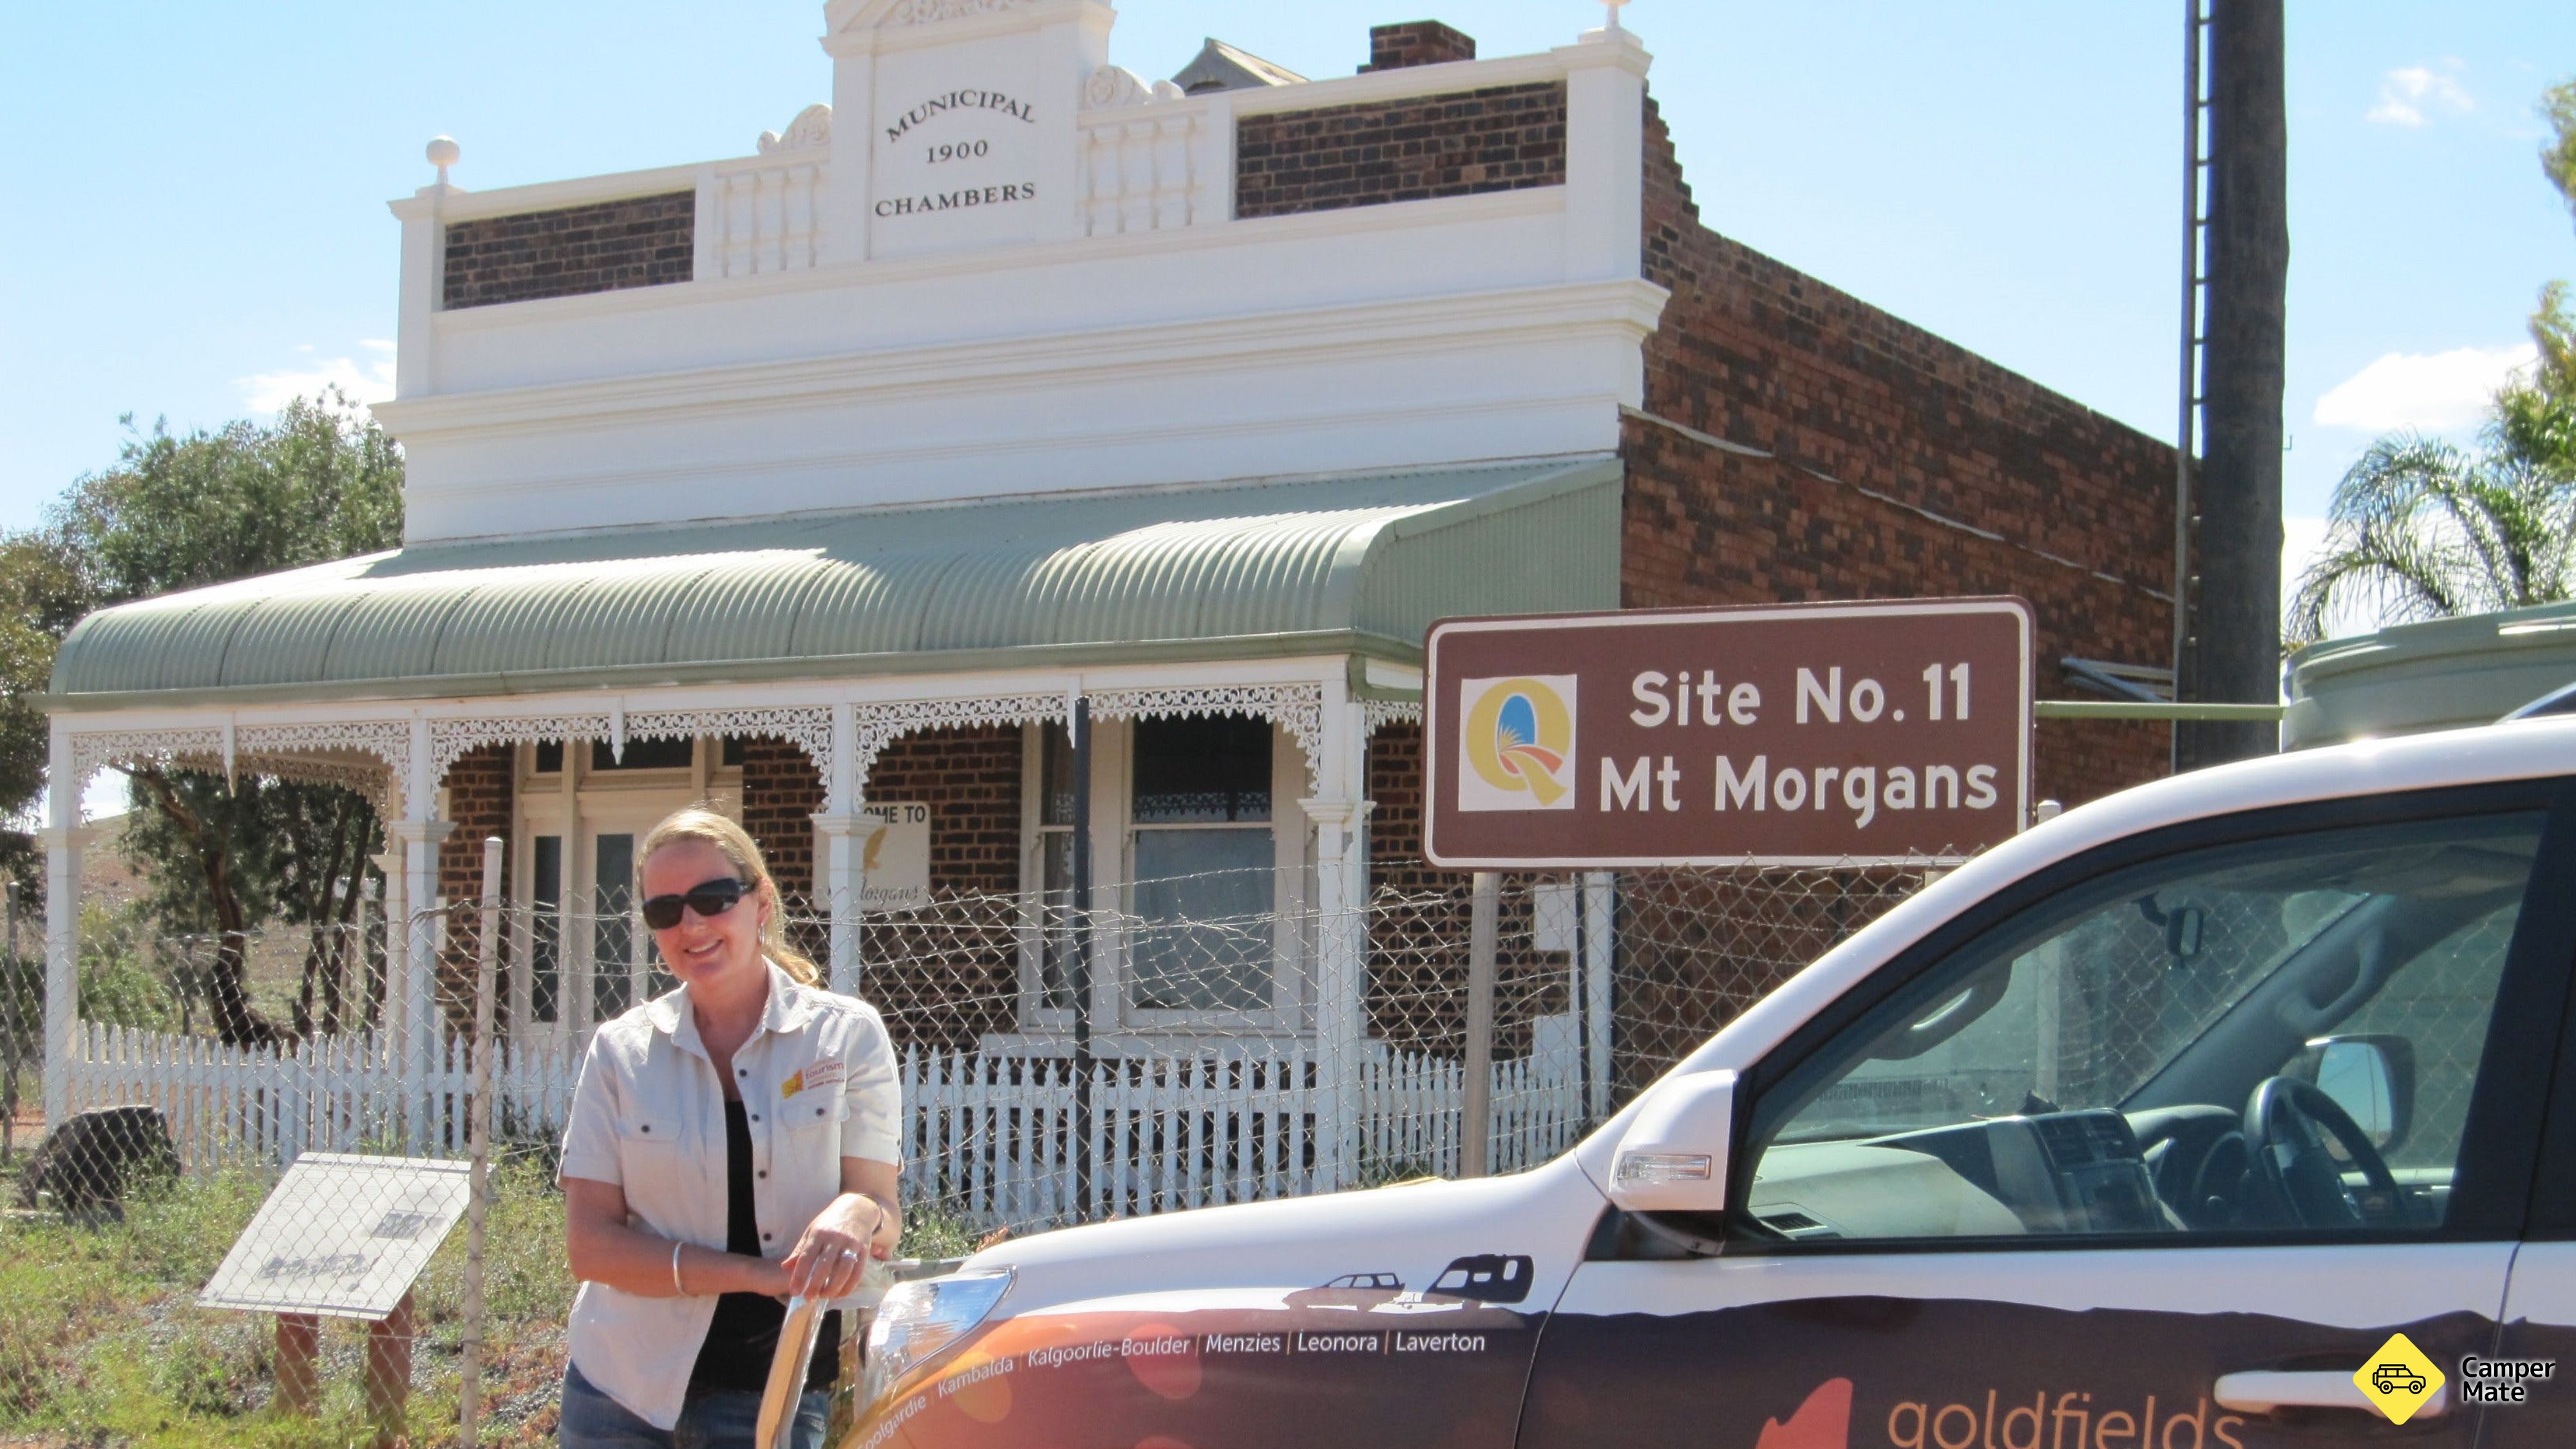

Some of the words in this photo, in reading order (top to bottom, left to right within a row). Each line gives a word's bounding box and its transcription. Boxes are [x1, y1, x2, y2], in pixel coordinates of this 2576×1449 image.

[886, 89, 1036, 143] MUNICIPAL
[927, 140, 989, 164] 1900
[875, 182, 1036, 217] CHAMBERS
[1630, 670, 1760, 728] Site
[1795, 667, 1904, 724] No.
[1922, 663, 1969, 720] 11
[904, 805, 926, 824] TO
[1600, 756, 1681, 813] Mt
[1714, 755, 1997, 829] Morgans
[938, 1357, 1014, 1398] Kambalda
[1028, 1336, 1190, 1370] Kalgoorlie-Boulder
[1206, 1332, 1281, 1353] Menzies
[1298, 1331, 1378, 1353] Leonora
[1396, 1331, 1485, 1352] Laverton
[1888, 1389, 2245, 1449] goldfields
